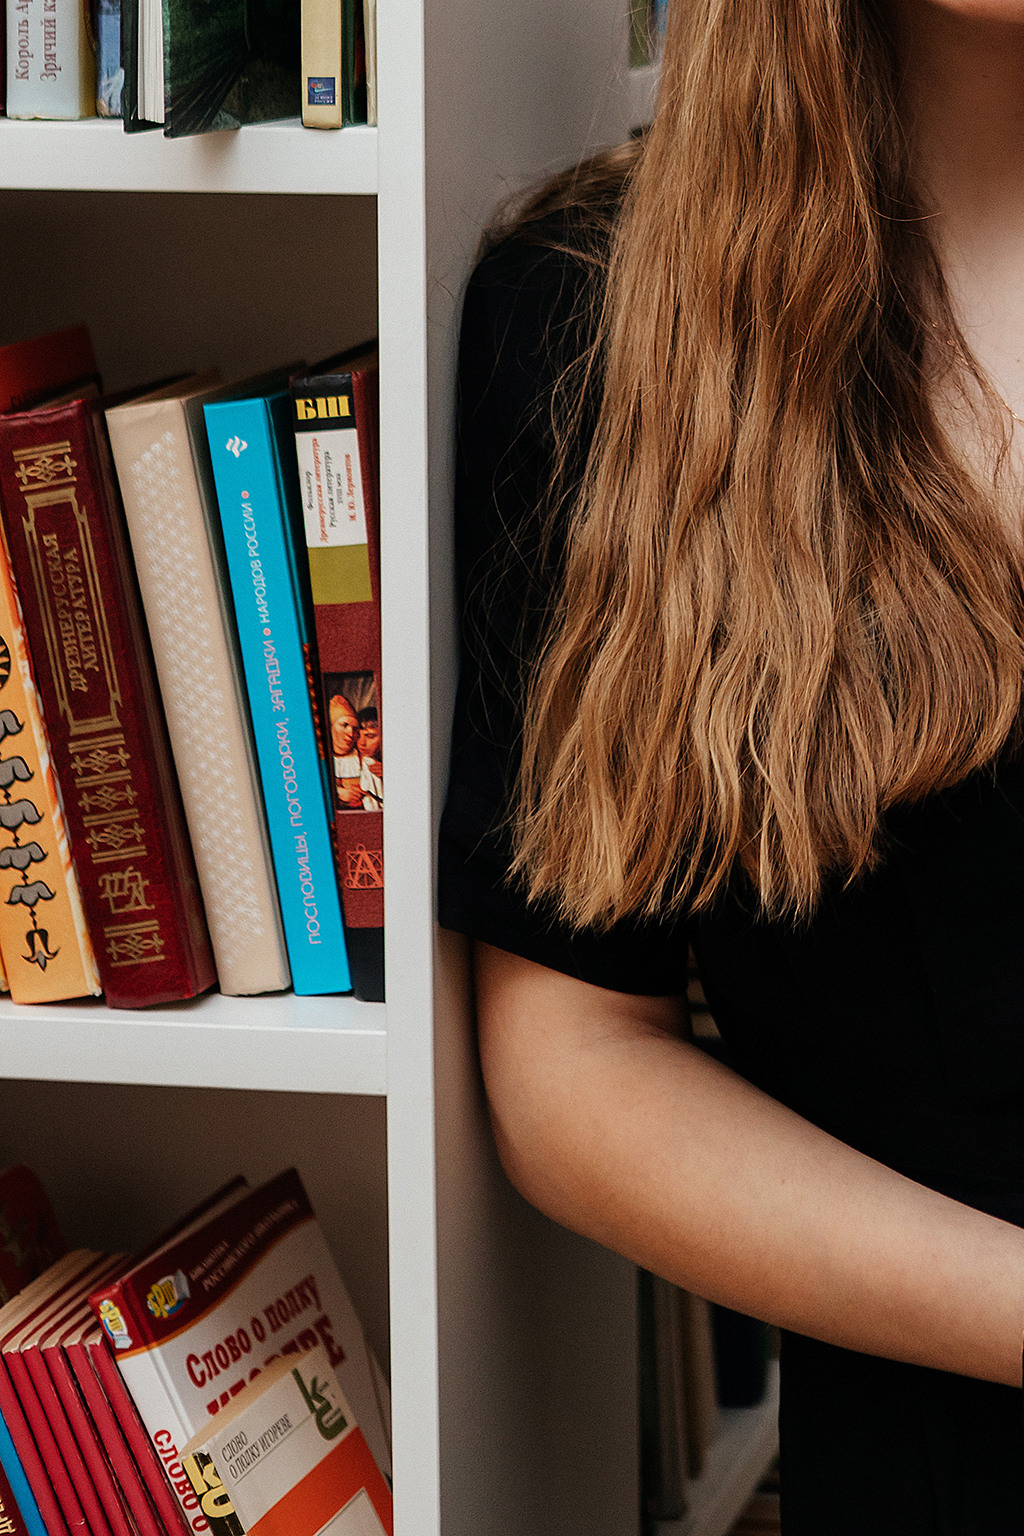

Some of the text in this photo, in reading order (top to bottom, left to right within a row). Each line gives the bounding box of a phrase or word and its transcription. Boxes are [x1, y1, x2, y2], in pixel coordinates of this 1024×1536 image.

[15, 19, 34, 81] Король
[40, 18, 62, 82] Зрячий
[295, 395, 351, 421] БШ
[241, 502, 271, 624] НАРОДОВ РОССИИ
[42, 533, 89, 693] ДРЕВНЕРУССКАЯ
[63, 547, 100, 673] ЛИТЕРАТУРА
[262, 639, 322, 945] ПОСЛОВИЦЫ, ПОГОВОРКИ, ЗАГАДКИ
[154, 1429, 210, 1533] СЛОВО О
[221, 1430, 250, 1463] СЛОВО
[228, 1464, 242, 1480] О
[235, 1443, 263, 1475] ПОЛКУ
[260, 1412, 295, 1455] ИГОРЕВЕ
